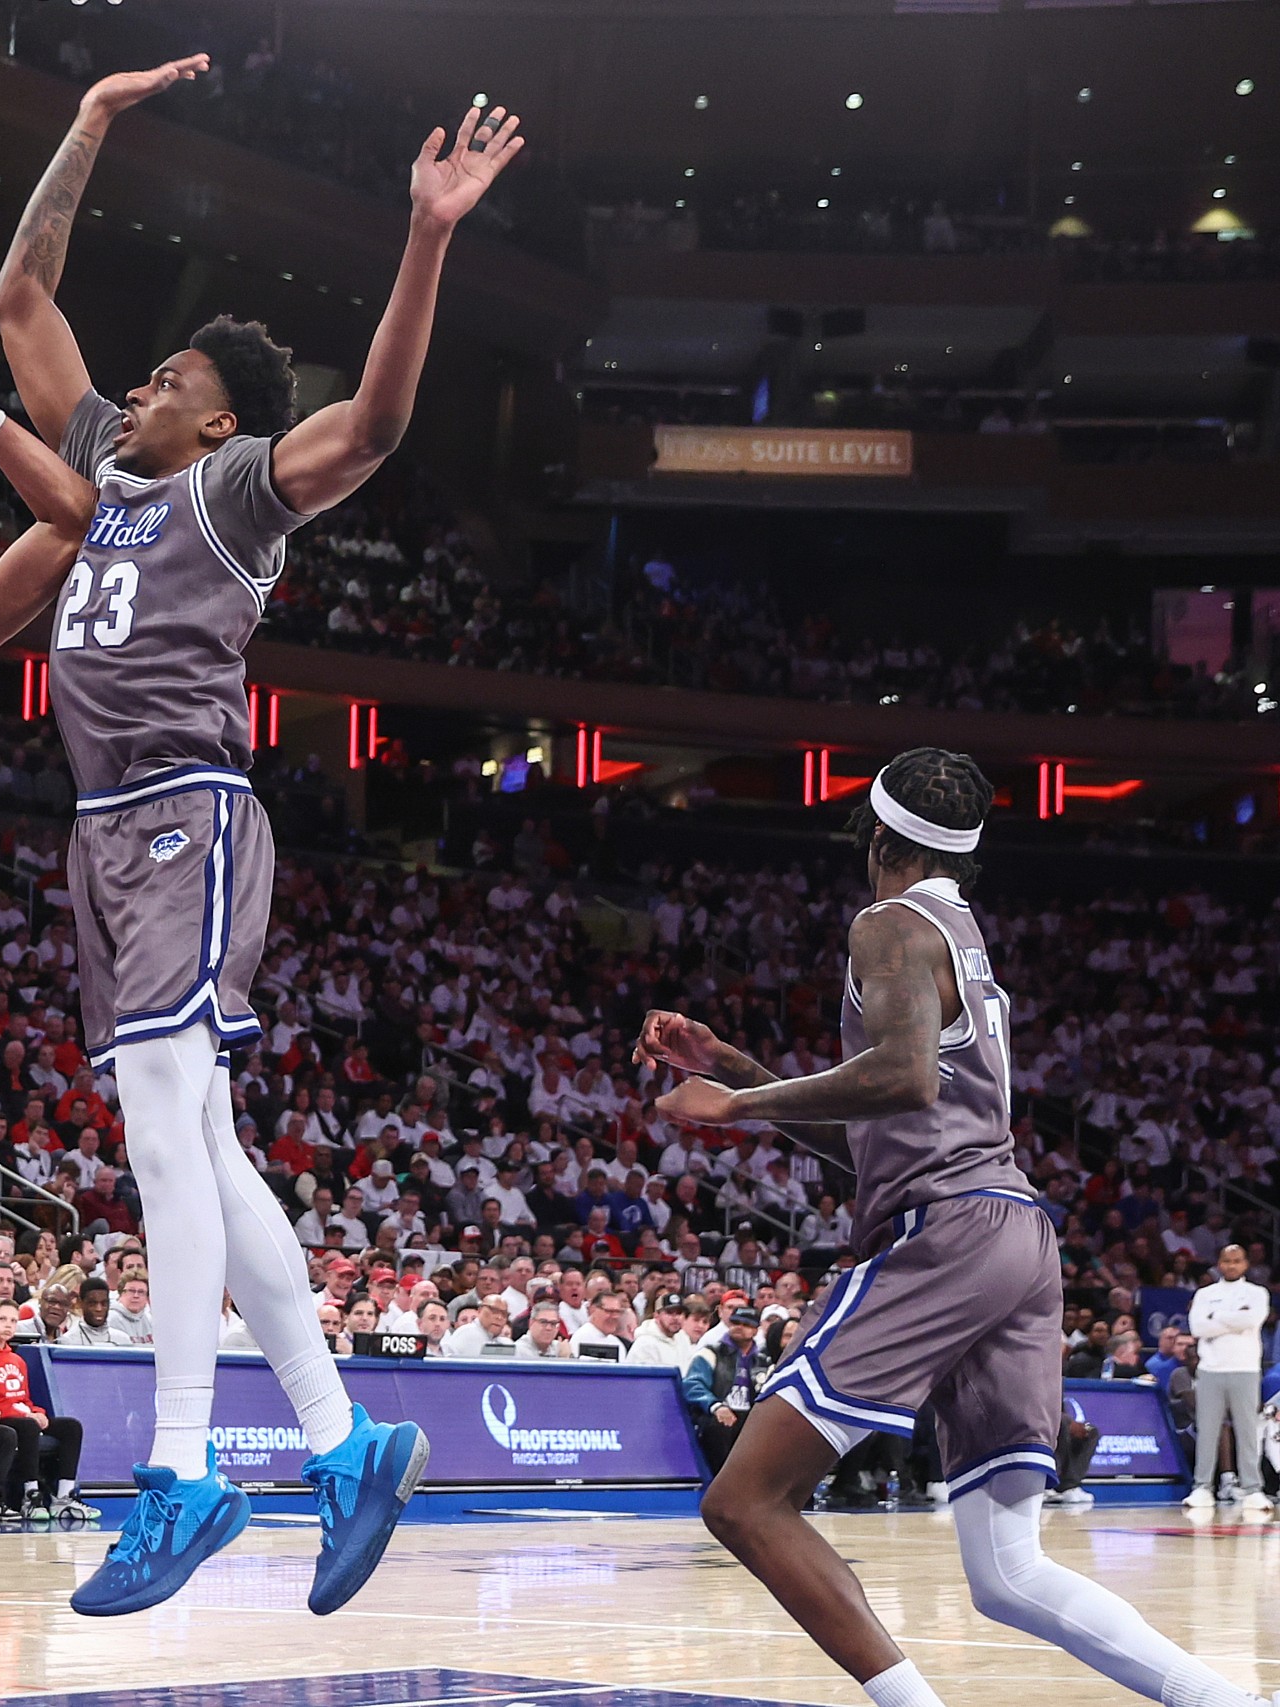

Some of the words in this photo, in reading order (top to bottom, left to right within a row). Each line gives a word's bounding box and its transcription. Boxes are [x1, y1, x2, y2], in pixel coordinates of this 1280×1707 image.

[750, 439, 820, 463] SUITE
[828, 441, 903, 465] LEVEL
[90, 504, 170, 547] Hall
[56, 559, 141, 649] 23
[983, 996, 1011, 1118] 7
[381, 1336, 417, 1354] POSS
[509, 1429, 622, 1451] PROFESSIONAL
[231, 1453, 272, 1466] THERAPY
